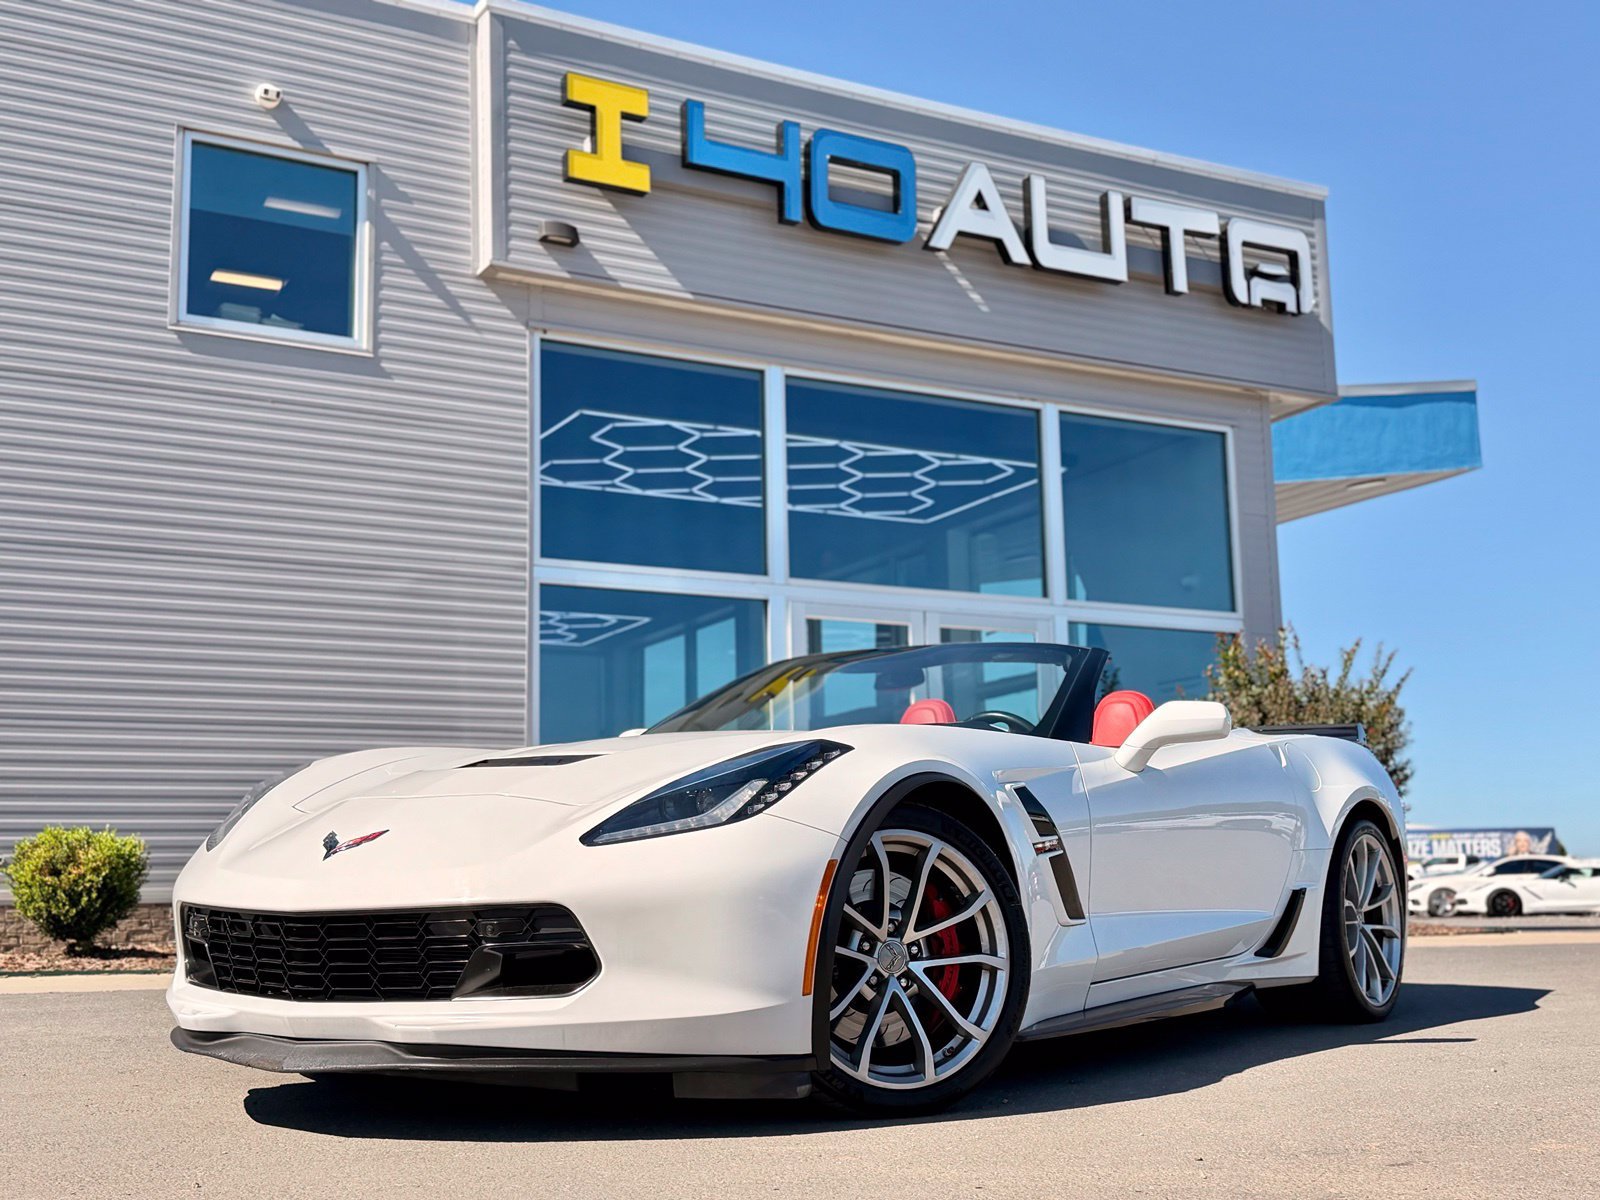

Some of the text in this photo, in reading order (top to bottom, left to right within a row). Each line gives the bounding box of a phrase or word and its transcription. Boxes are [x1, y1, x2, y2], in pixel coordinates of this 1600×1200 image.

[562, 72, 651, 196] I
[681, 99, 917, 244] 40
[1407, 840, 1431, 857] IZE
[1432, 838, 1501, 858] MATTERS
